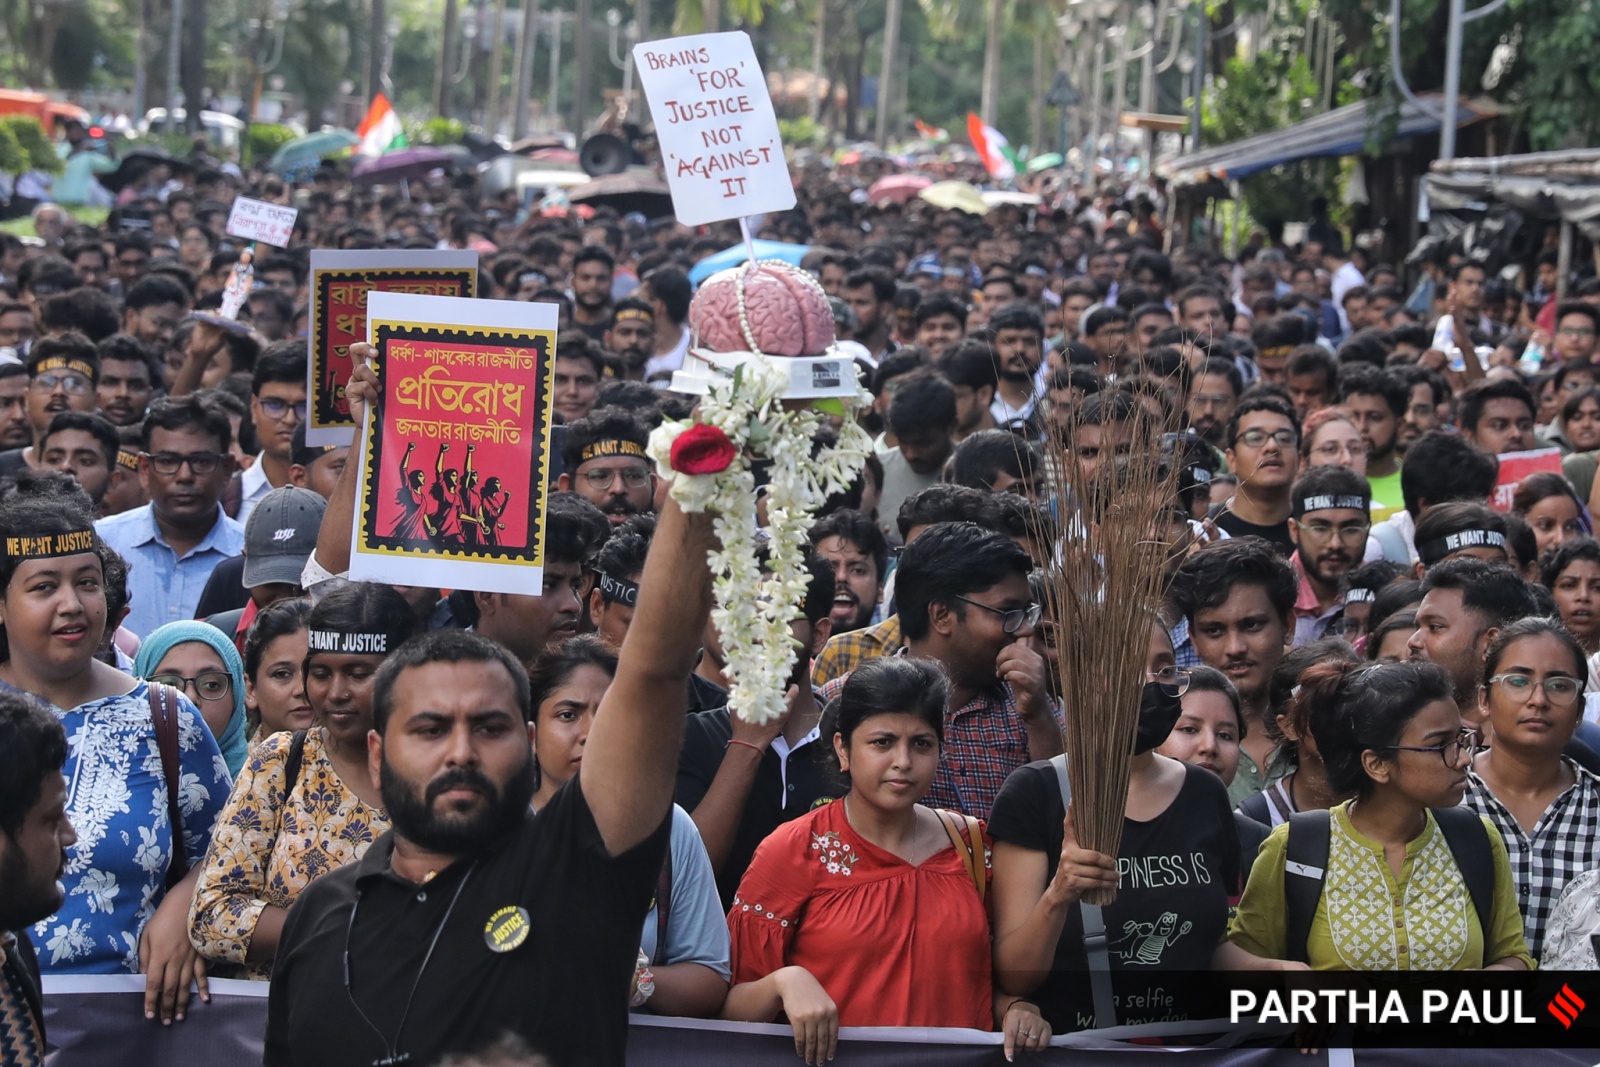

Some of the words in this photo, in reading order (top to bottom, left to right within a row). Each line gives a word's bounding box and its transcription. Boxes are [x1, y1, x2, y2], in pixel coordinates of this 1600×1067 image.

[644, 47, 710, 70] BRAINS
[689, 61, 745, 92] 'FOR'
[664, 95, 754, 124] JUSTICE
[701, 125, 742, 148] NOT
[670, 139, 774, 179] 'AGAINST'
[720, 177, 747, 198] IT
[424, 347, 476, 367] শাসকের
[477, 348, 534, 370] রাজনীতি
[395, 365, 526, 417] প্রতিরোধ
[395, 418, 452, 439] জনতার
[454, 418, 522, 445] রাজনীতি
[6, 537, 20, 556] WE
[55, 530, 93, 553] JUSTICE
[1445, 533, 1460, 550] WE
[1459, 530, 1485, 546] WANT
[600, 571, 636, 603] JUSTIC
[307, 629, 314, 649] E
[314, 630, 340, 651] WANT
[342, 632, 387, 652] JUSTICE
[1116, 855, 1190, 889] PINESS
[1190, 852, 1211, 884] IS
[493, 912, 525, 945] JUSTICE
[1126, 987, 1174, 1009] selfie
